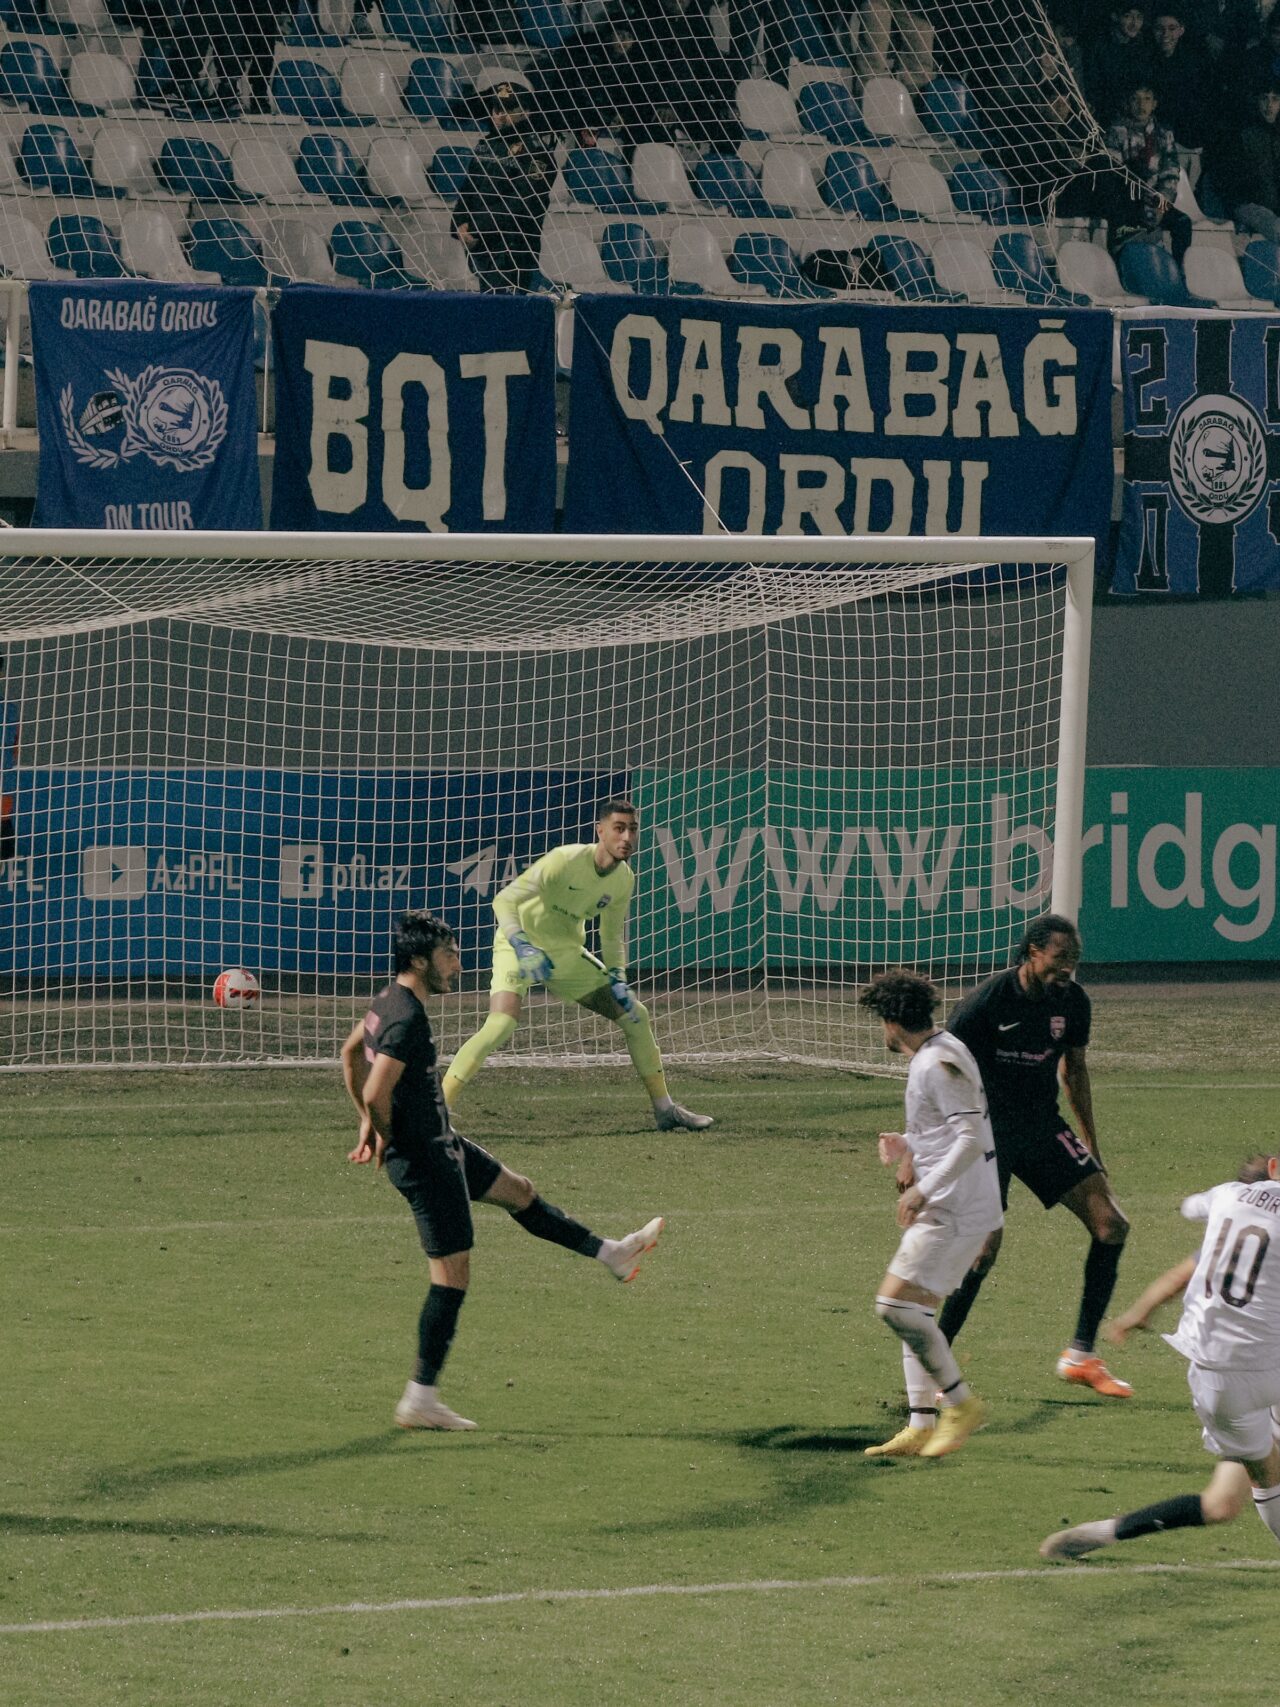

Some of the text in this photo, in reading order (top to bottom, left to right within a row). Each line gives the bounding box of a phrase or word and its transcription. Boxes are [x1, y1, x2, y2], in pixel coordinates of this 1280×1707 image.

[60, 295, 217, 332] QARABAĞ ORDU
[610, 313, 1078, 438] QARABAĞ
[303, 338, 531, 533] BQT
[105, 501, 194, 530] ON TOUR
[703, 450, 989, 535] ORDU
[151, 854, 243, 891] AzPFL
[1205, 1217, 1270, 1308] 10
